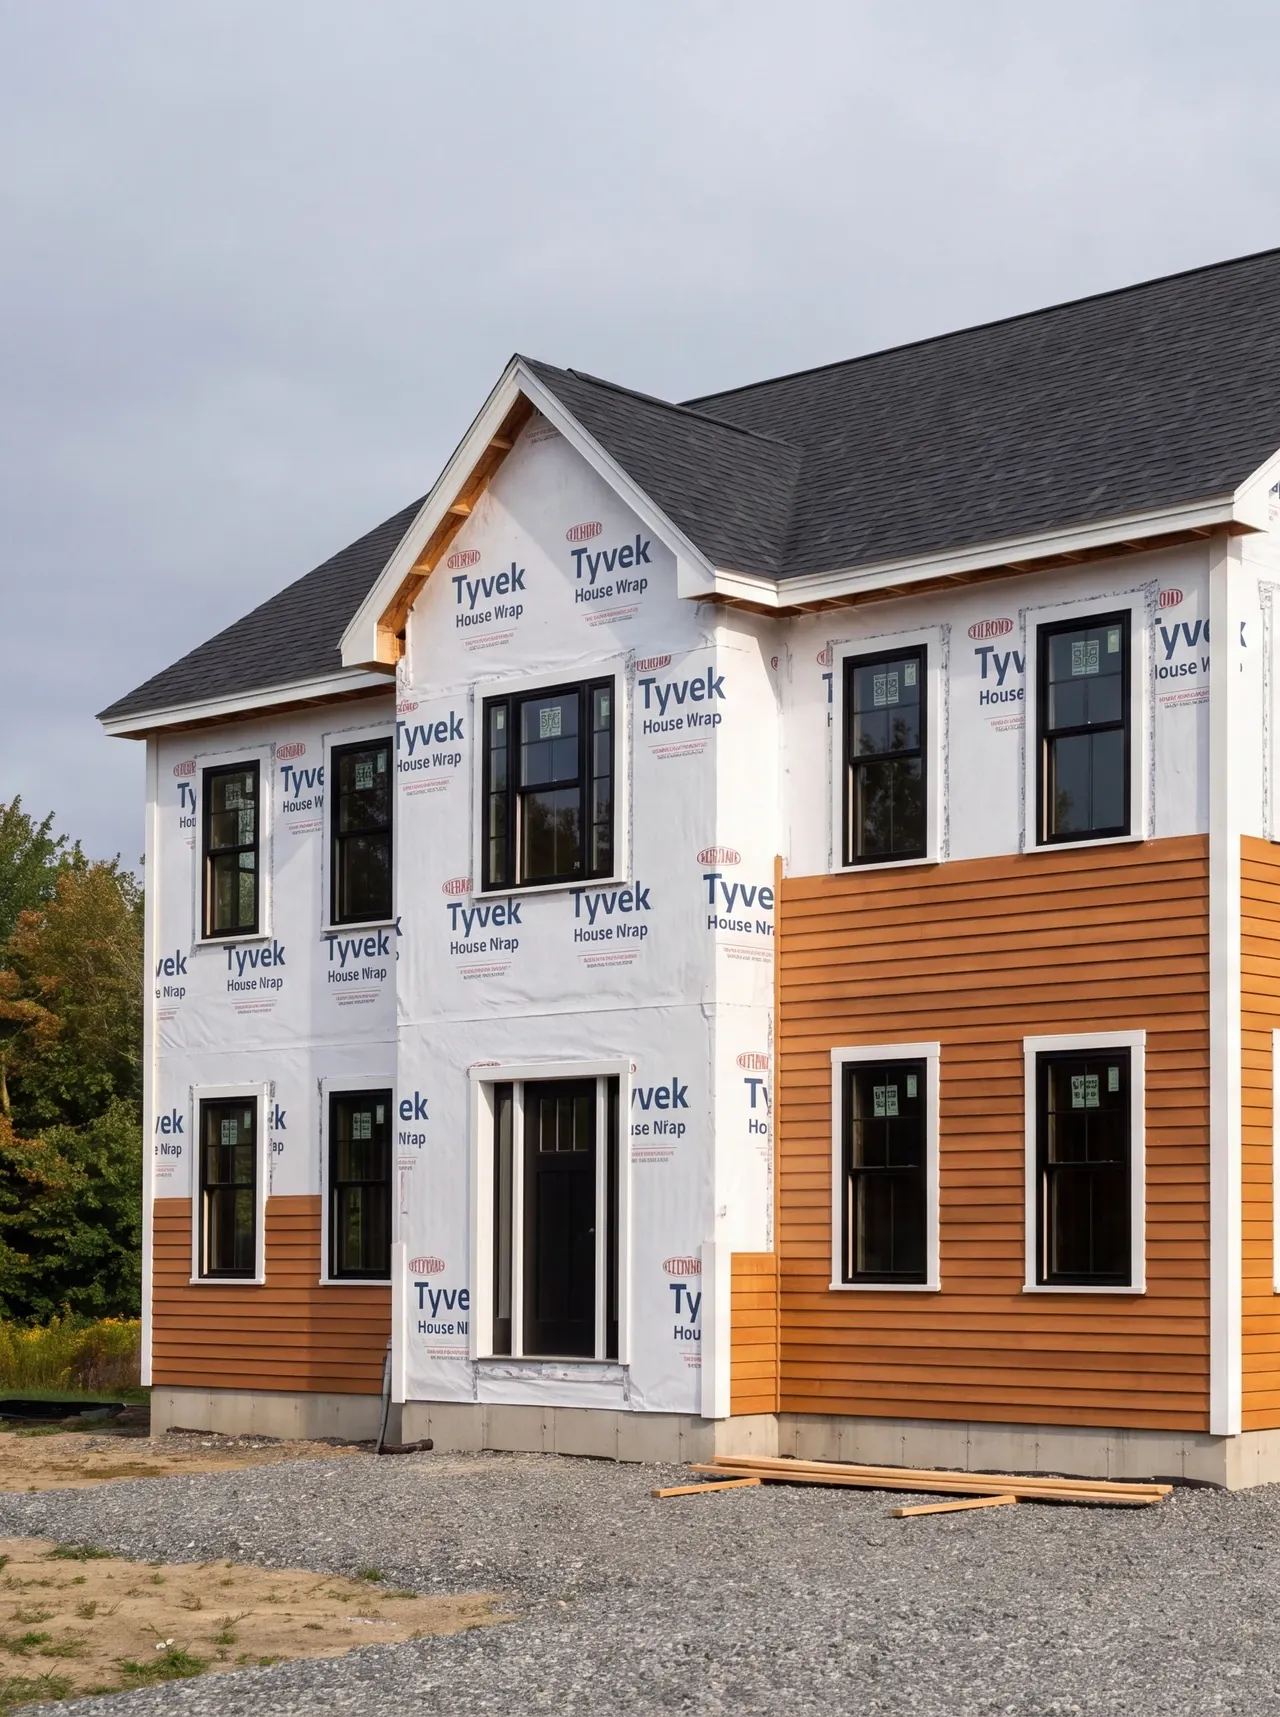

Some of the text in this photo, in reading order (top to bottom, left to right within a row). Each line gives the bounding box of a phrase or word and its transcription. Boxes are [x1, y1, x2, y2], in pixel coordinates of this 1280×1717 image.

[571, 534, 651, 585] Tyvek
[452, 562, 526, 610] Tyvek
[575, 577, 648, 603] House Wrap
[456, 604, 524, 628] House Wrap
[974, 646, 1025, 686] Tyv
[639, 666, 726, 716] Tyvek
[979, 687, 1024, 706] House
[643, 712, 722, 735] House Wrap
[432, 751, 462, 768] Wrap
[280, 764, 324, 798] Tyve
[283, 797, 312, 813] House
[569, 880, 651, 925] Tyvek
[703, 873, 773, 913] Tyve
[447, 898, 522, 938] Tyvek
[707, 915, 753, 934] House
[324, 929, 389, 967] Tyvek
[450, 939, 487, 955] House
[574, 927, 613, 943] House
[156, 949, 187, 977] vek
[223, 939, 286, 977] Tyvek
[227, 979, 257, 992] House
[328, 969, 359, 983] House
[155, 1108, 184, 1134] vek
[414, 1281, 470, 1318] Tyve
[417, 1320, 454, 1336] House
[673, 1325, 701, 1341] Hou
